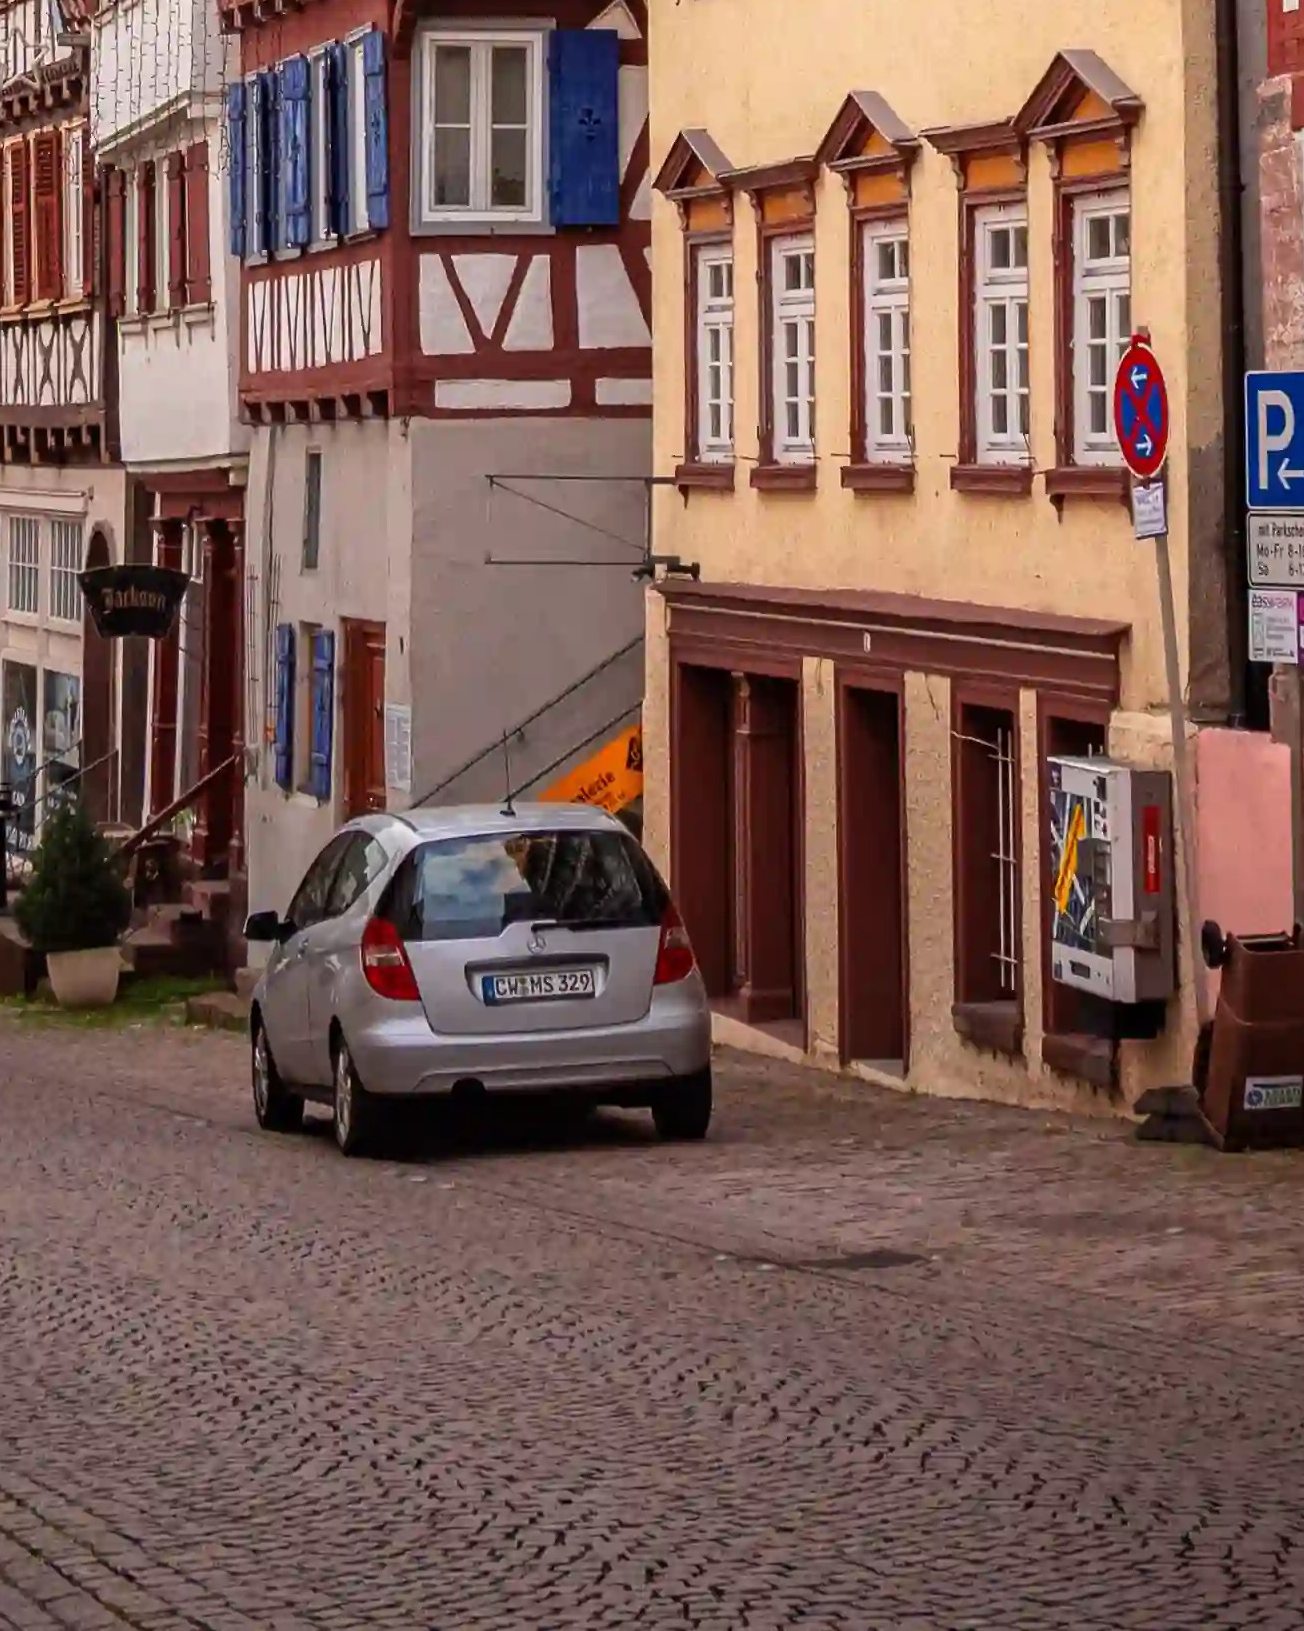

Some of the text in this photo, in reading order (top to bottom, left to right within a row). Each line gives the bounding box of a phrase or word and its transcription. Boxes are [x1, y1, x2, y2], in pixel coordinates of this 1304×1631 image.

[1258, 389, 1295, 489] P
[495, 974, 590, 996] CW MS 329
